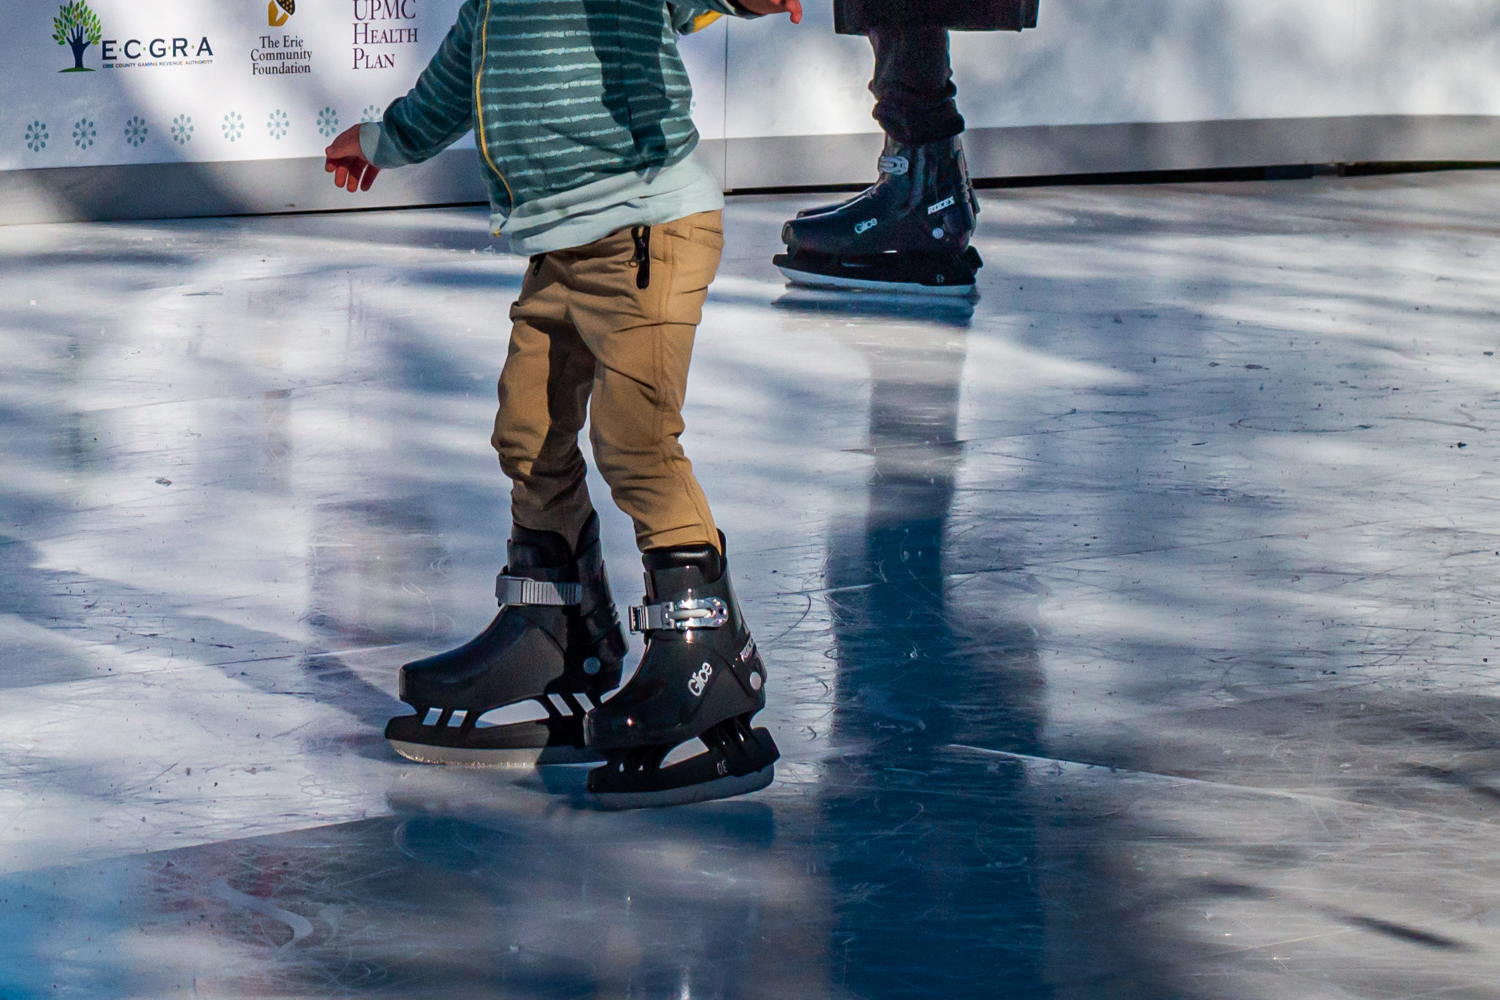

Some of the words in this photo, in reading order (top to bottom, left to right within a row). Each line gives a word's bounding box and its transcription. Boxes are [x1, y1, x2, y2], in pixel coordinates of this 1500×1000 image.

[259, 35, 280, 49] The
[283, 34, 304, 48] Erie
[352, 22, 419, 45] HEALTH
[250, 47, 313, 62] Community
[352, 47, 396, 70] PLAN
[252, 61, 311, 76] Foundation
[854, 218, 878, 234] Glice
[687, 662, 713, 696] Glice
